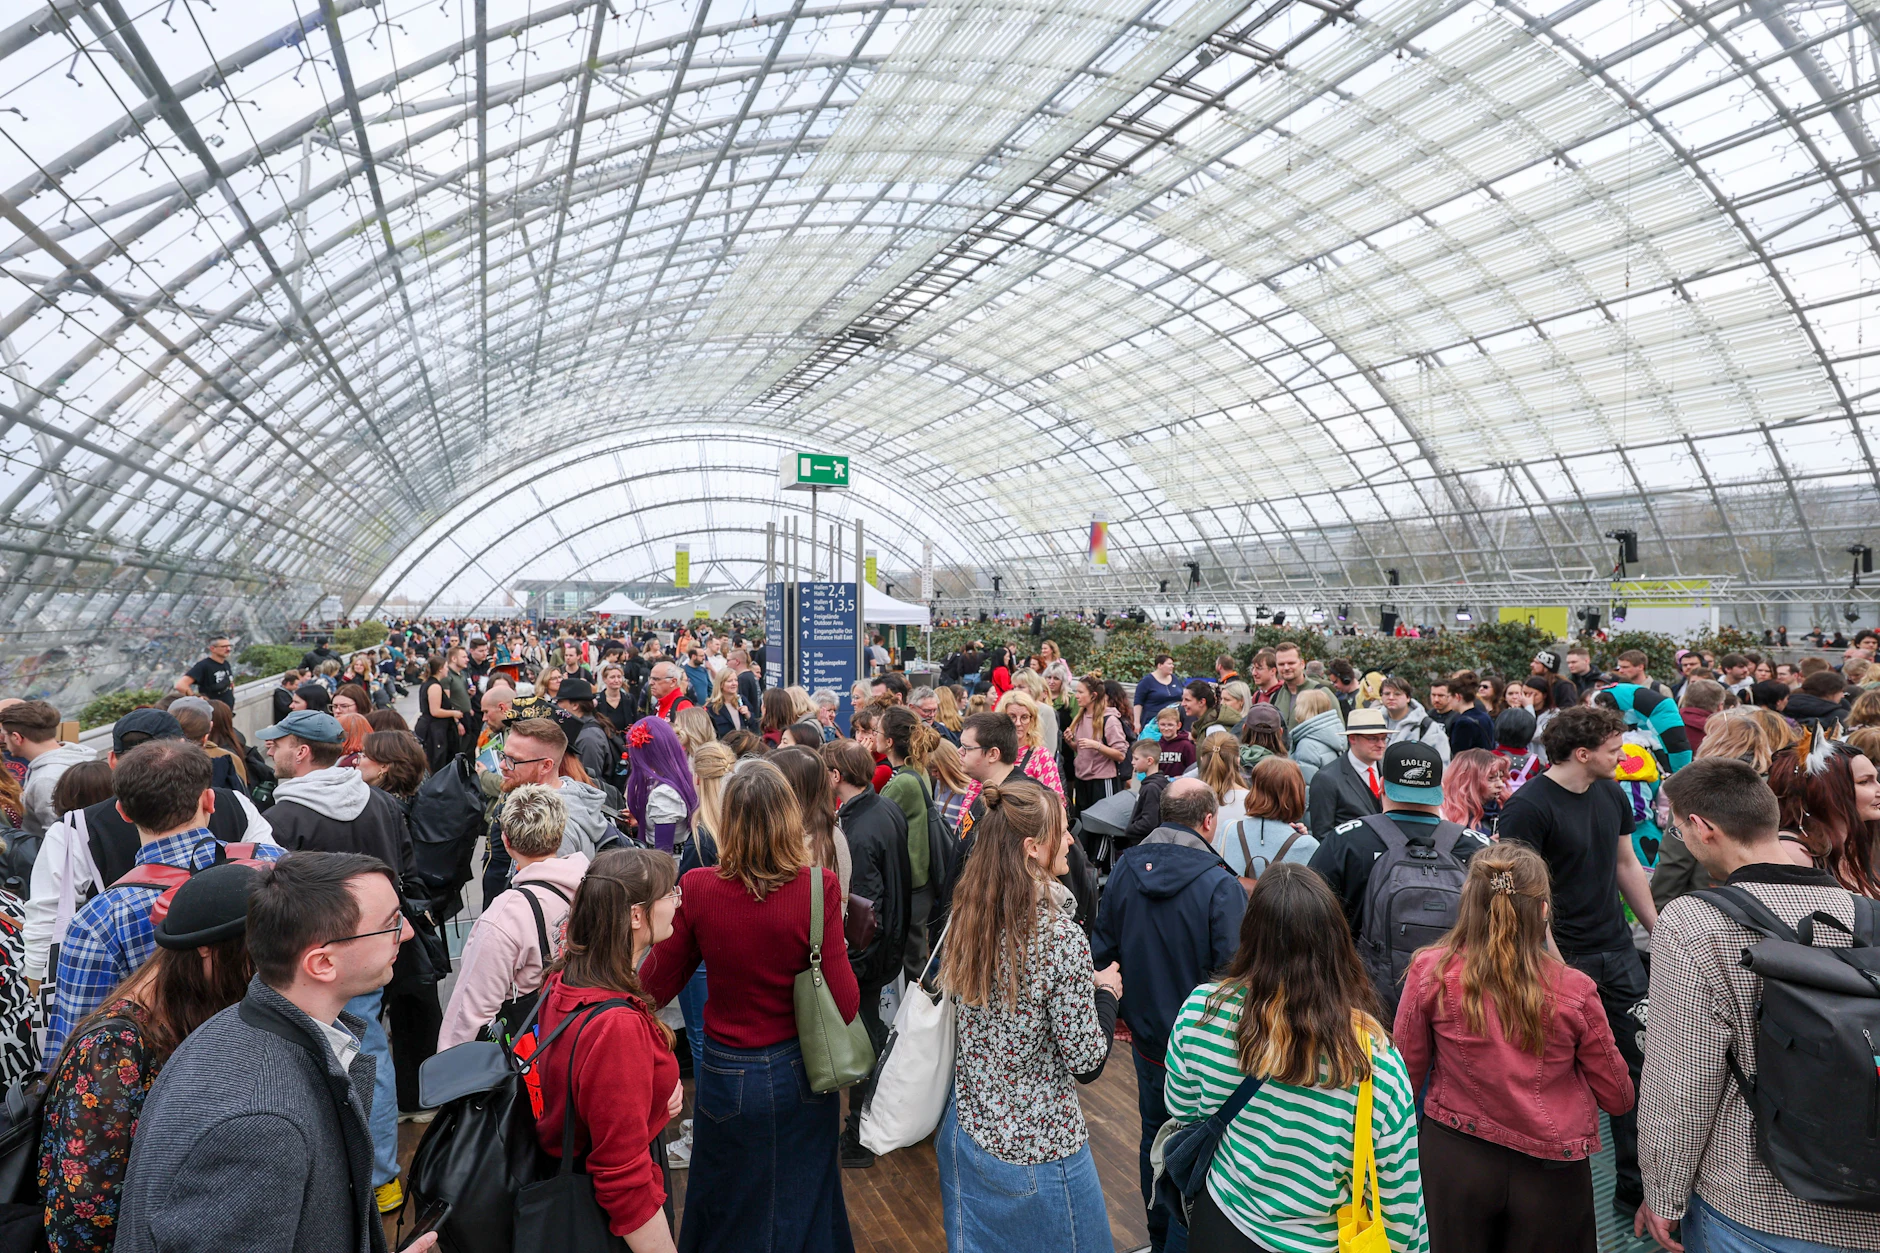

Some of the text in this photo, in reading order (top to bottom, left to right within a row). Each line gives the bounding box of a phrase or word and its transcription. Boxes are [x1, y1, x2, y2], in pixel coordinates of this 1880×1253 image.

[828, 584, 846, 598] 2,4
[828, 599, 855, 613] 1,3,5
[1159, 751, 1182, 763] SPEN
[1400, 758, 1432, 769] EAGLES
